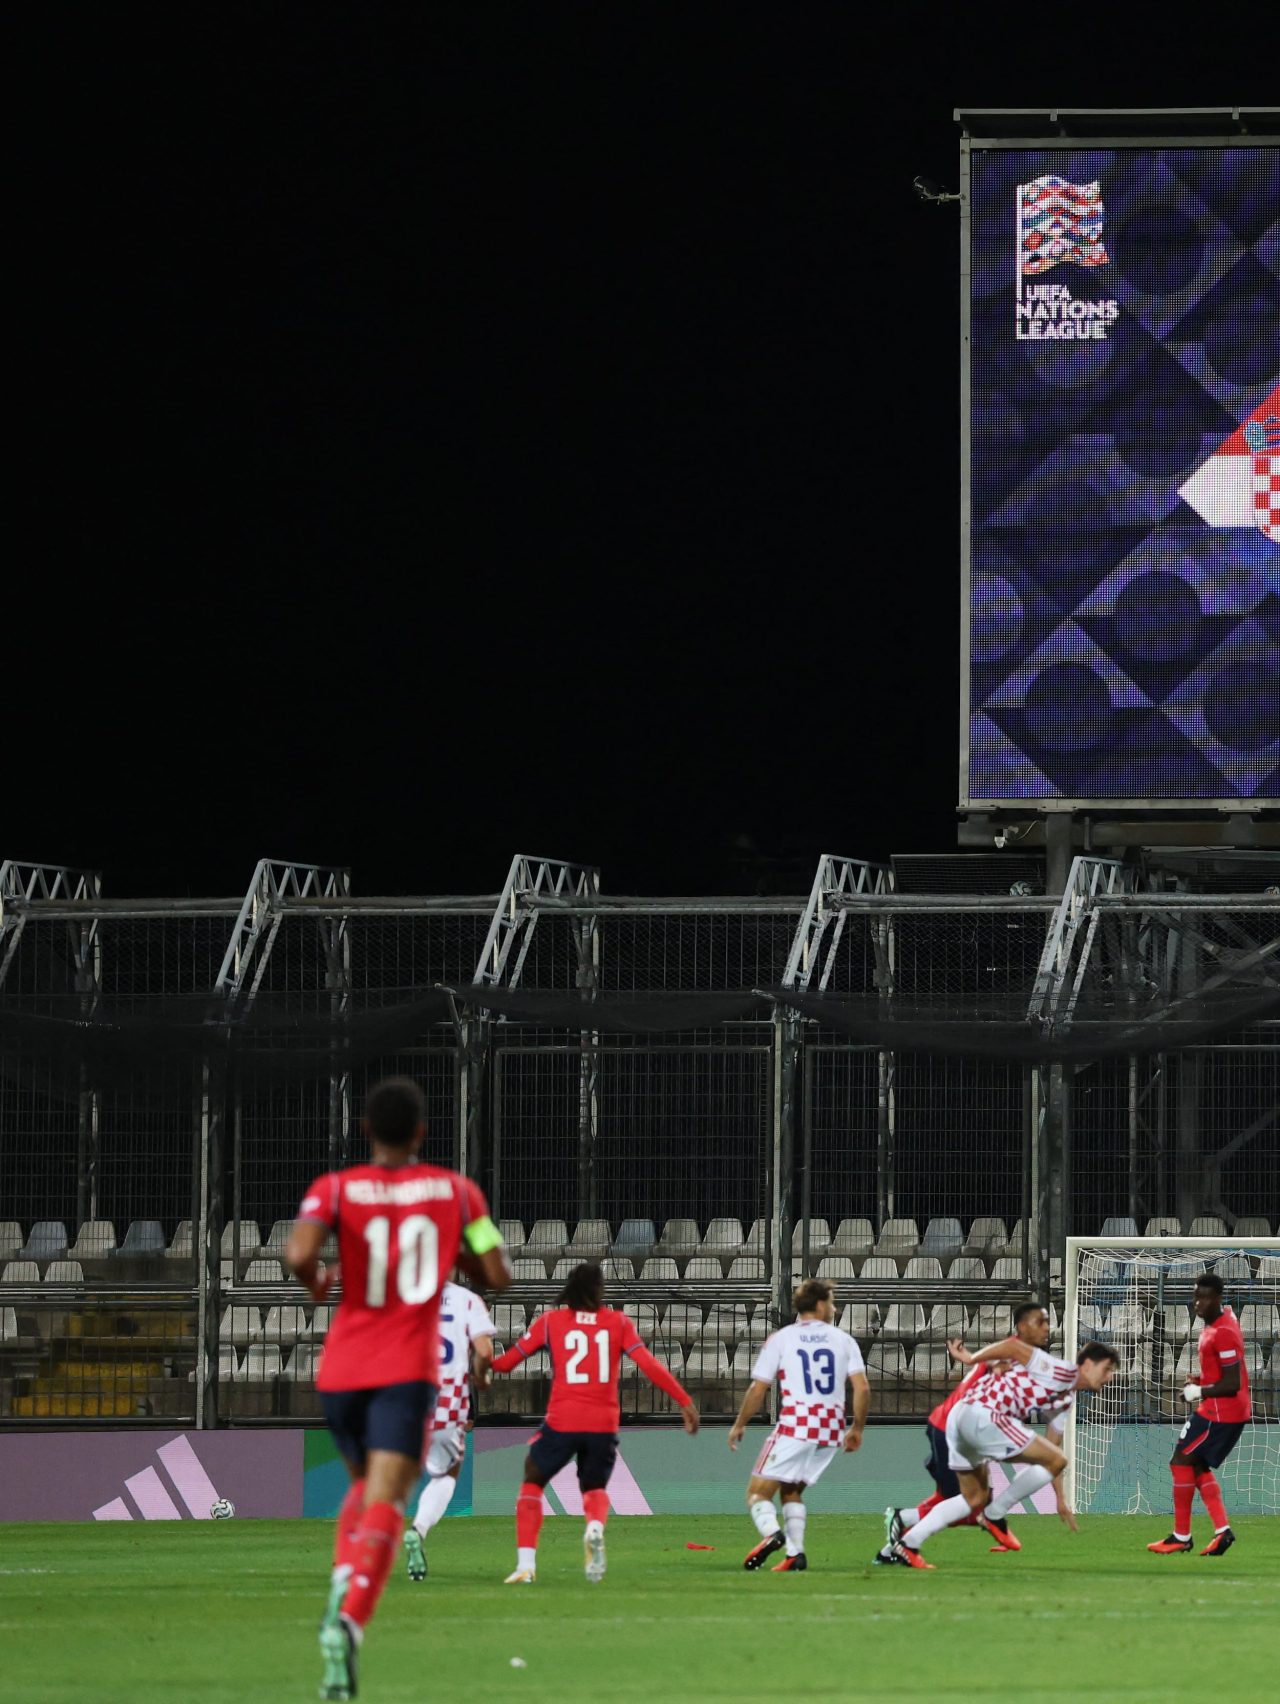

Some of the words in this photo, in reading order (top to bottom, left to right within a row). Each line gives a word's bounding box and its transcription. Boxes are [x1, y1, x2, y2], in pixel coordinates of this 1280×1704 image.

[1027, 284, 1071, 300] UEFA
[1016, 300, 1120, 319] NATIONS
[1016, 320, 1108, 340] LEAGUE
[363, 1214, 439, 1308] 10
[564, 1328, 610, 1385] 21
[796, 1348, 835, 1395] 13
